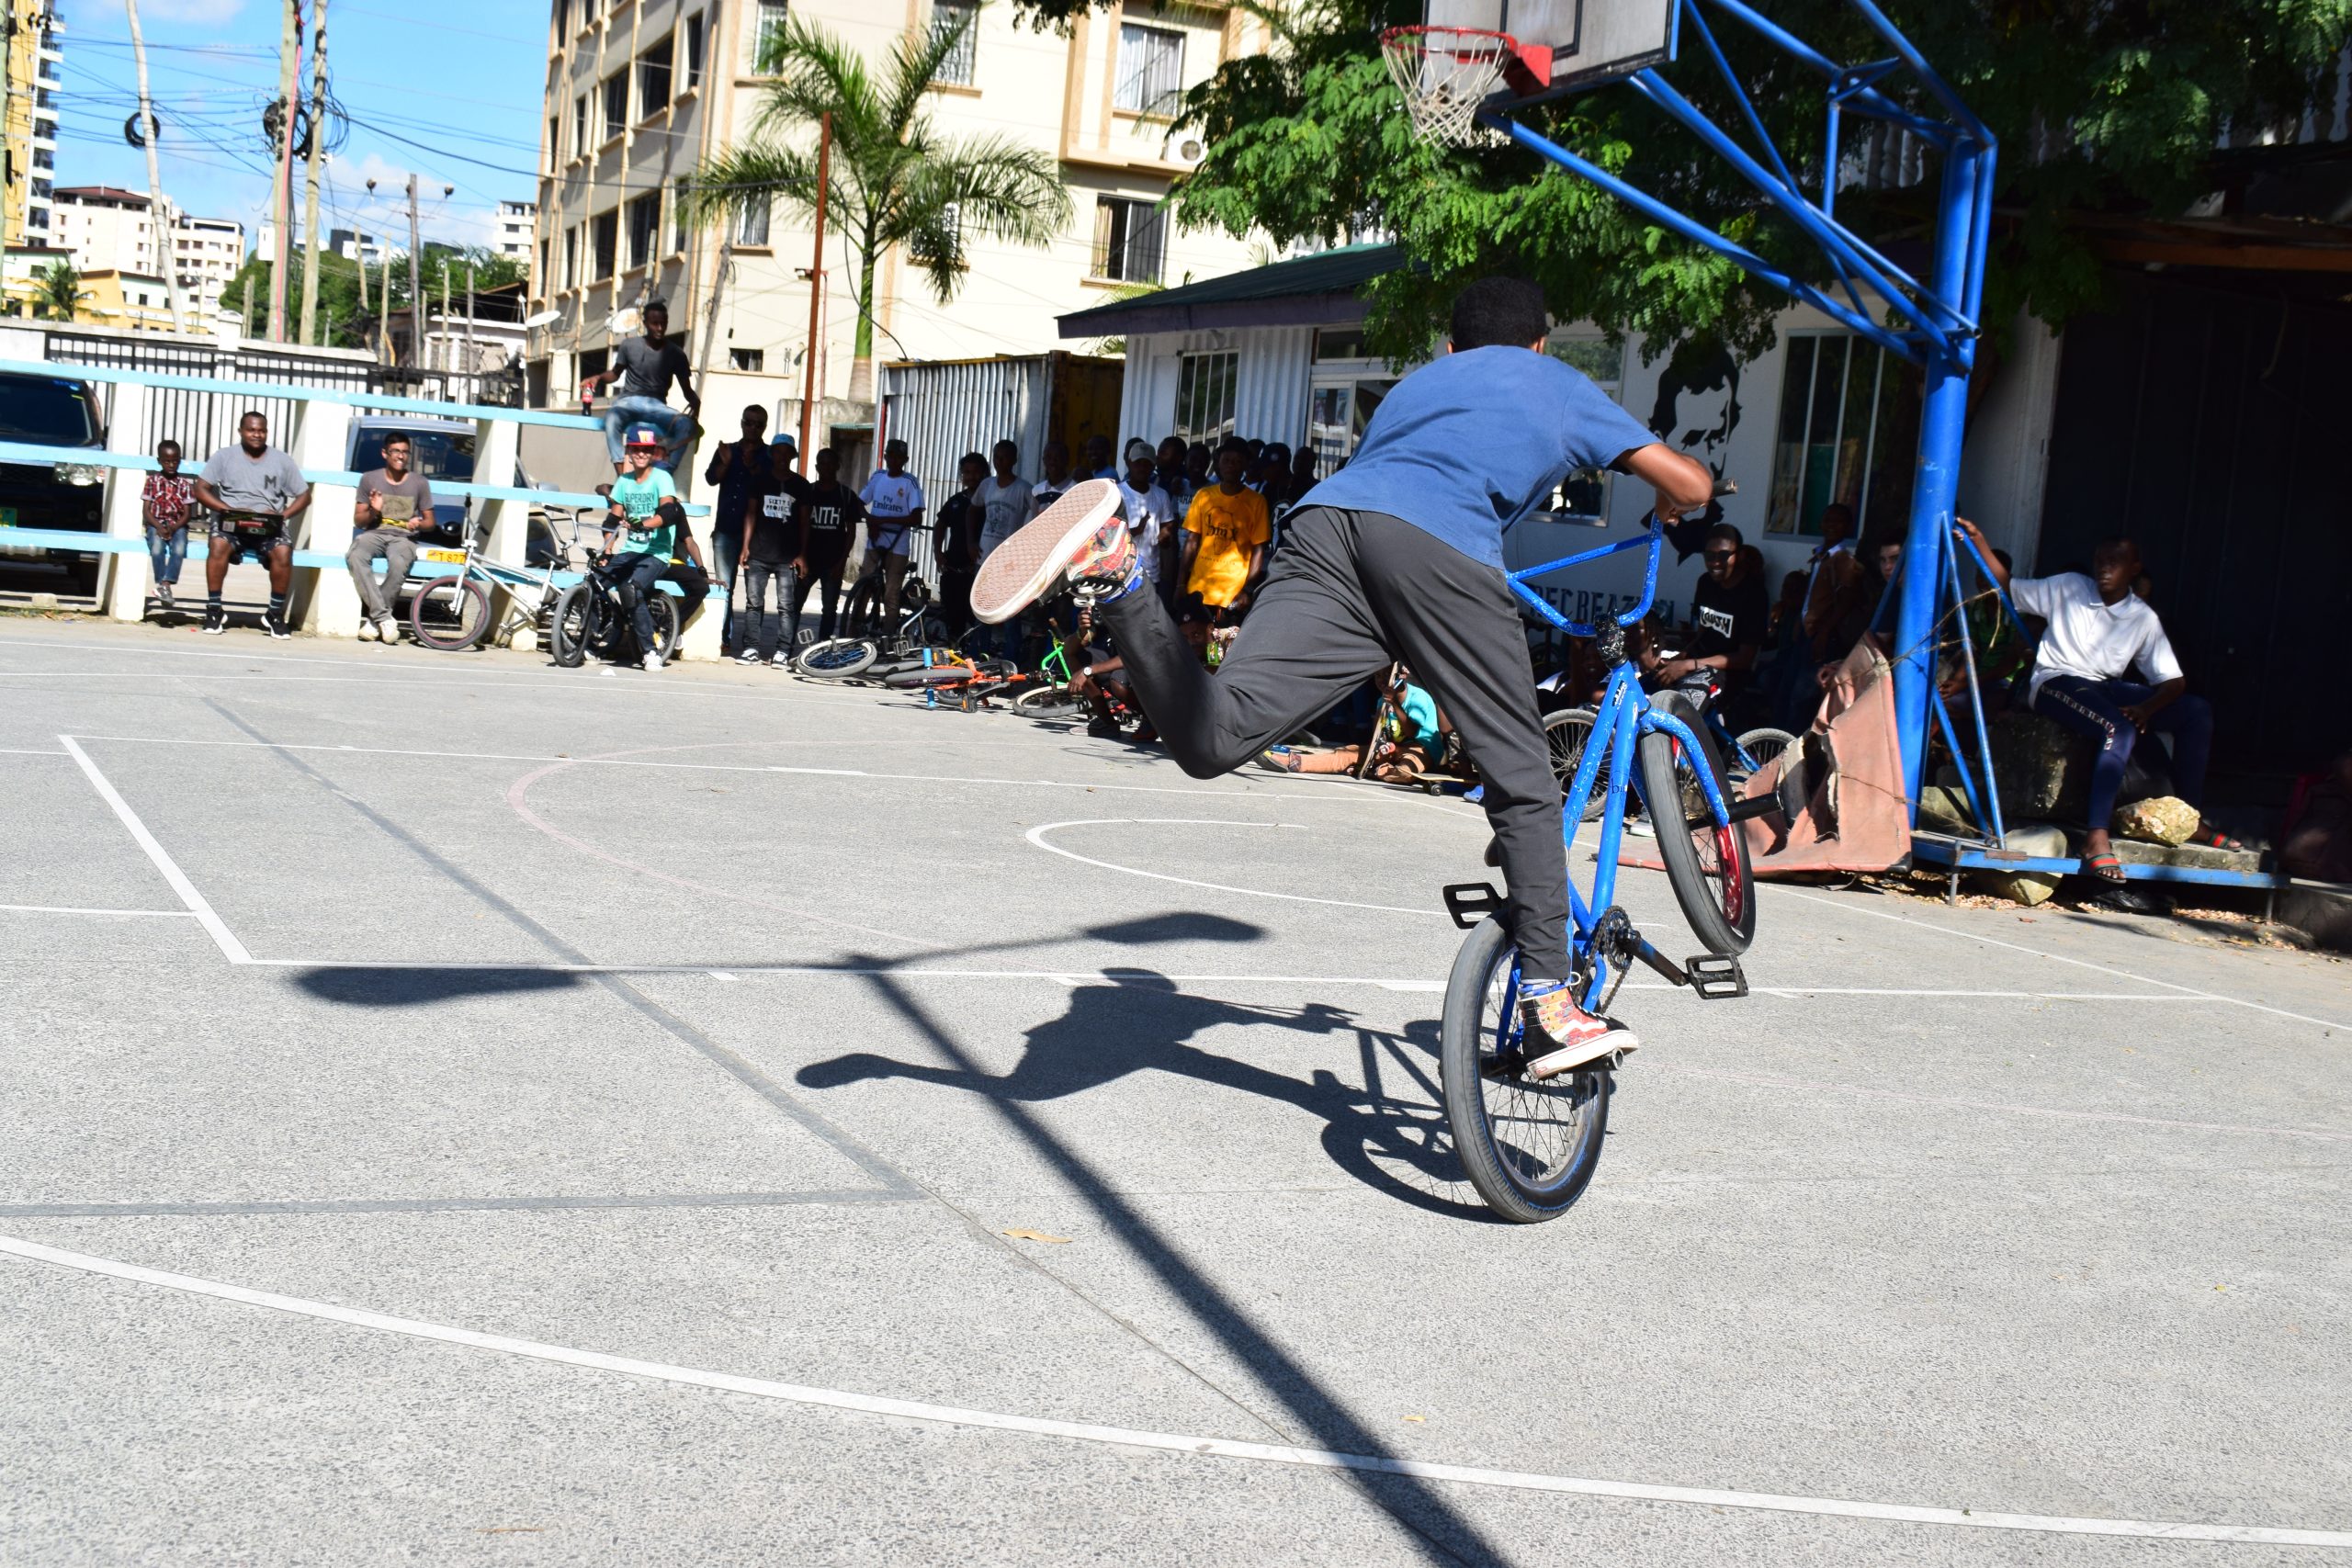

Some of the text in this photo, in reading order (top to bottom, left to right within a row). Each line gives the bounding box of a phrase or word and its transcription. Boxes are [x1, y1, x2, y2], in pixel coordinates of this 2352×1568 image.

[264, 474, 277, 490] M
[883, 495, 894, 503] Fly
[873, 500, 904, 513] Emirates
[810, 505, 842, 525] AITH
